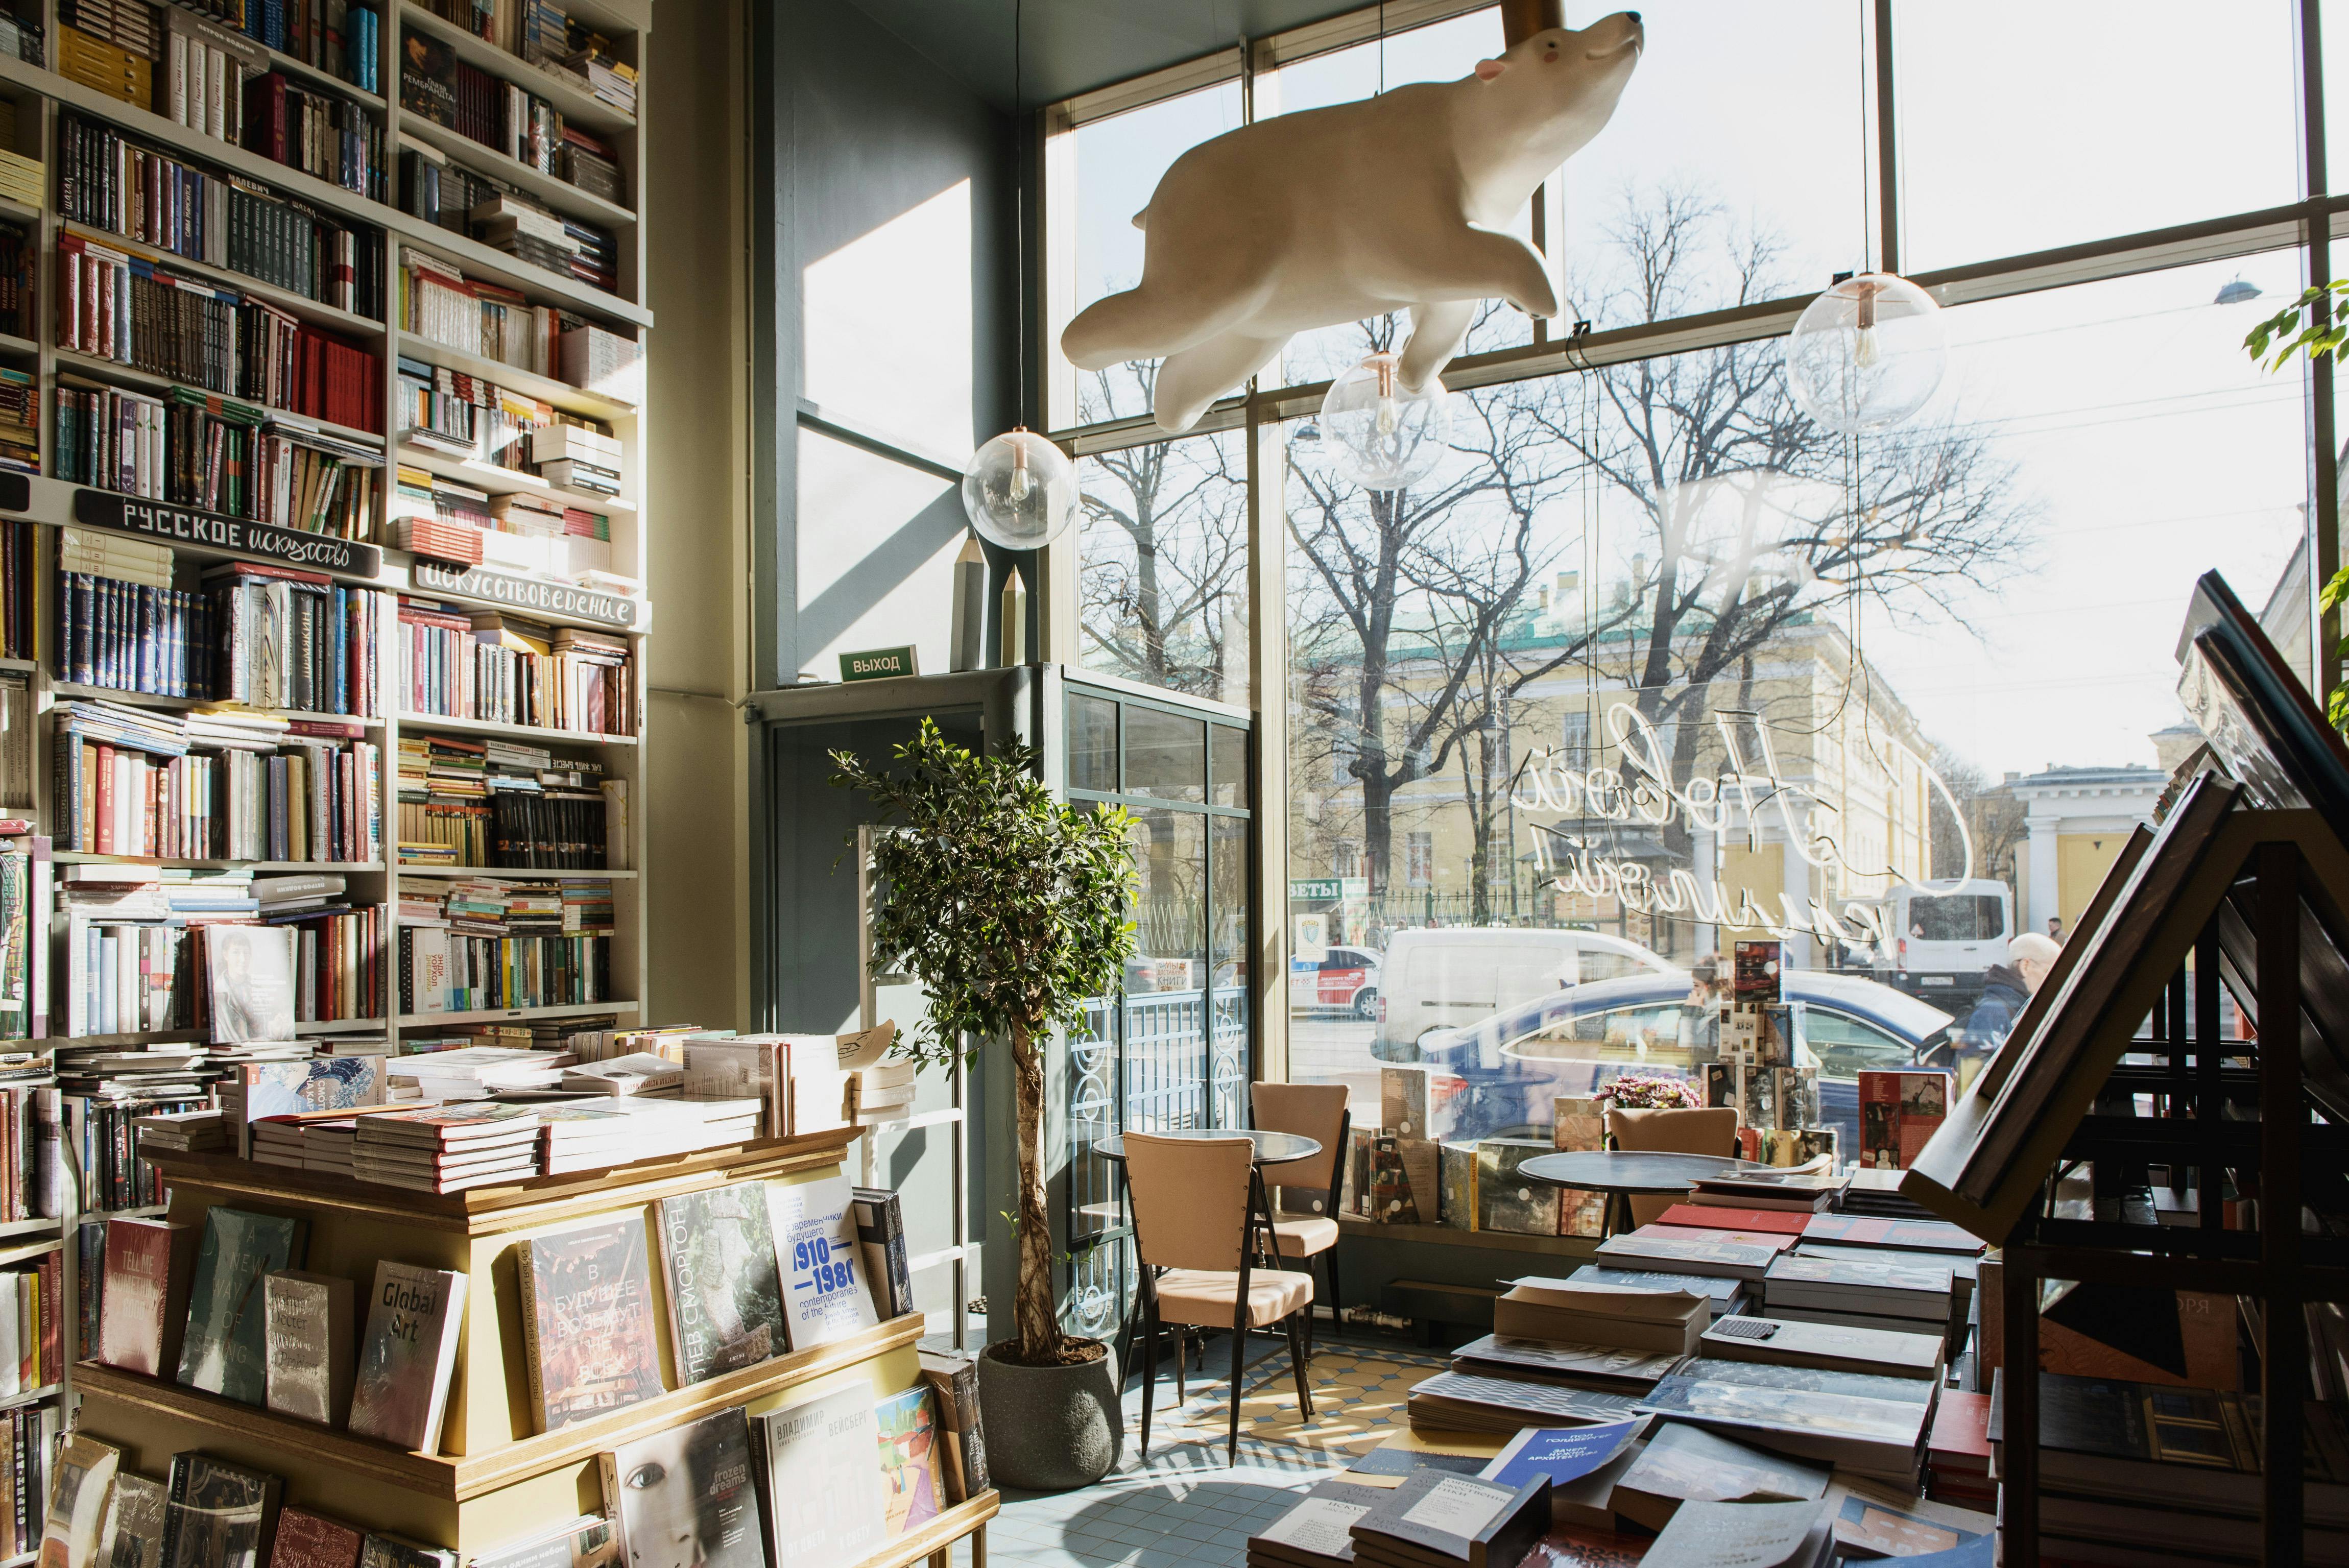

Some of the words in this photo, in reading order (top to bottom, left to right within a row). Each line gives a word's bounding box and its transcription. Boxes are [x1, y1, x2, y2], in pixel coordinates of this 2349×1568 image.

[197, 23, 255, 54] ПЕТРОВ-ВОДКИН
[403, 73, 454, 103] РЕМБРАНДТА
[428, 78, 447, 92] Глаза
[228, 173, 270, 195] МАЛЕВИЧ
[123, 502, 242, 547] РУССКОЕ
[301, 612, 311, 678] ШЕМЯКИН
[853, 656, 900, 673] ВЫХОД
[553, 759, 573, 770] ВМЕСТЕ
[574, 761, 590, 771] ЖИТЬ
[591, 763, 602, 771] КАК
[276, 883, 325, 893] ПЕТРОВ-ВОДКИН
[306, 1076, 314, 1090] НА
[640, 1079, 658, 1088] ИСТОРИЯ
[659, 1075, 677, 1084] КРАТКАЯ
[246, 1233, 255, 1242] A
[787, 1227, 824, 1245] будущего
[122, 1250, 138, 1272] TELL
[139, 1254, 154, 1275] ME
[229, 1252, 265, 1273] NEW
[521, 1249, 531, 1278] ИЛЬЯ
[588, 1264, 599, 1280] В
[670, 1208, 699, 1325] СМОРГОН
[212, 1280, 241, 1300] WAY
[270, 1287, 307, 1311] Joshua
[382, 1281, 438, 1317] Global
[555, 1279, 635, 1313] БУДУЩЕЕ
[800, 1286, 858, 1308] contemporaries
[222, 1312, 242, 1329] OF
[271, 1308, 308, 1332] Decter
[525, 1293, 535, 1339] ЭМИЛИЯ
[557, 1302, 640, 1338] ВОЗЬМУТ
[802, 1308, 811, 1320] of
[811, 1306, 823, 1317] the
[387, 1314, 419, 1343] Art
[588, 1338, 612, 1355] НЕ
[686, 1330, 706, 1373] ЛЕВ
[529, 1342, 539, 1400] КАБАКОВЫ
[579, 1356, 626, 1381] ВСЕХ
[776, 1410, 825, 1441] ВЛАДИМИР
[828, 1409, 868, 1437] ВЕЙСБЕРГ
[778, 1439, 790, 1448] АННА
[1546, 1433, 1613, 1442] ГОЛДБЕРГЕР
[973, 1428, 984, 1481] РЕМБРАНДТА
[1528, 1450, 1598, 1461] АРХИТЕКТУРА
[713, 1463, 746, 1483] frozen
[709, 1473, 747, 1496] dreams
[539, 1543, 566, 1559] небом
